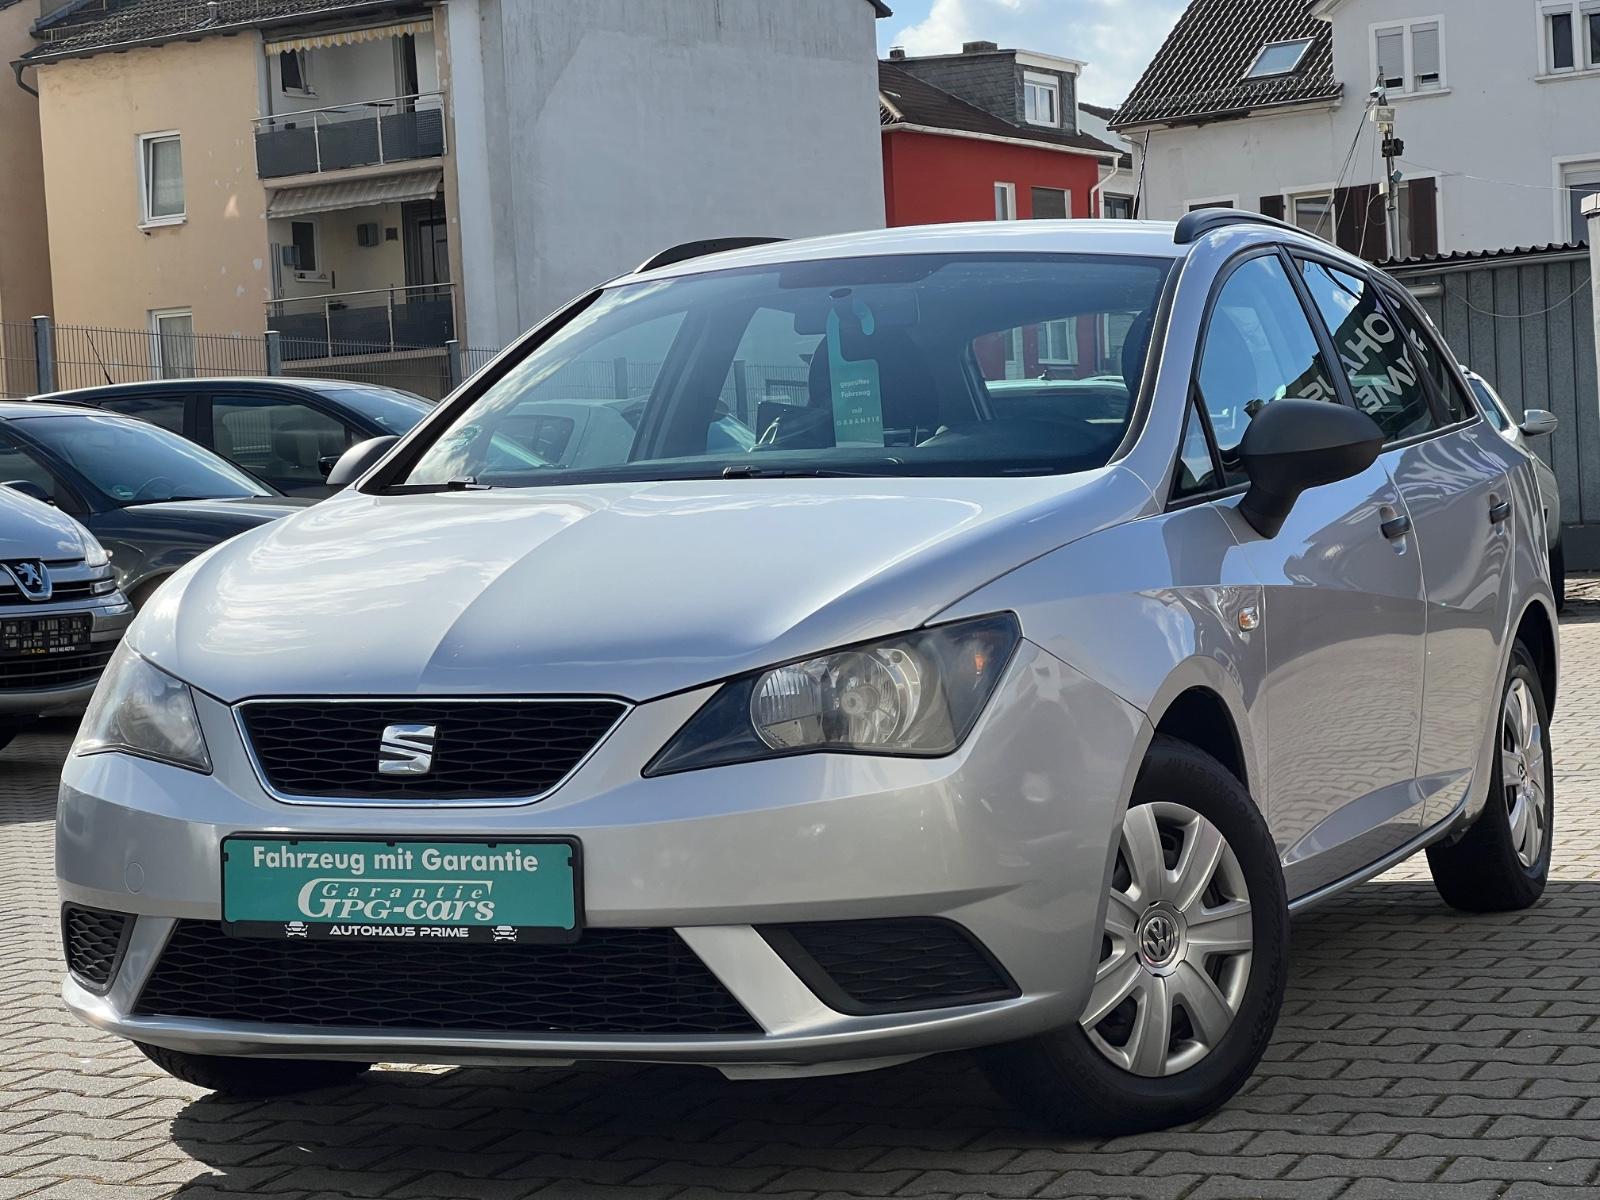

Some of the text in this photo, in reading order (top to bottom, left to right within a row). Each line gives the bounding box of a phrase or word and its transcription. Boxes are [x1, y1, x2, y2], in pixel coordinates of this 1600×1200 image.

[841, 391, 870, 399] Fahrzeug
[837, 416, 879, 425] GARANTIE
[253, 846, 538, 875] Fahrzeug mit Garantie
[321, 882, 483, 898] Garantie
[329, 925, 469, 938] AUTOHAUS PRIME
